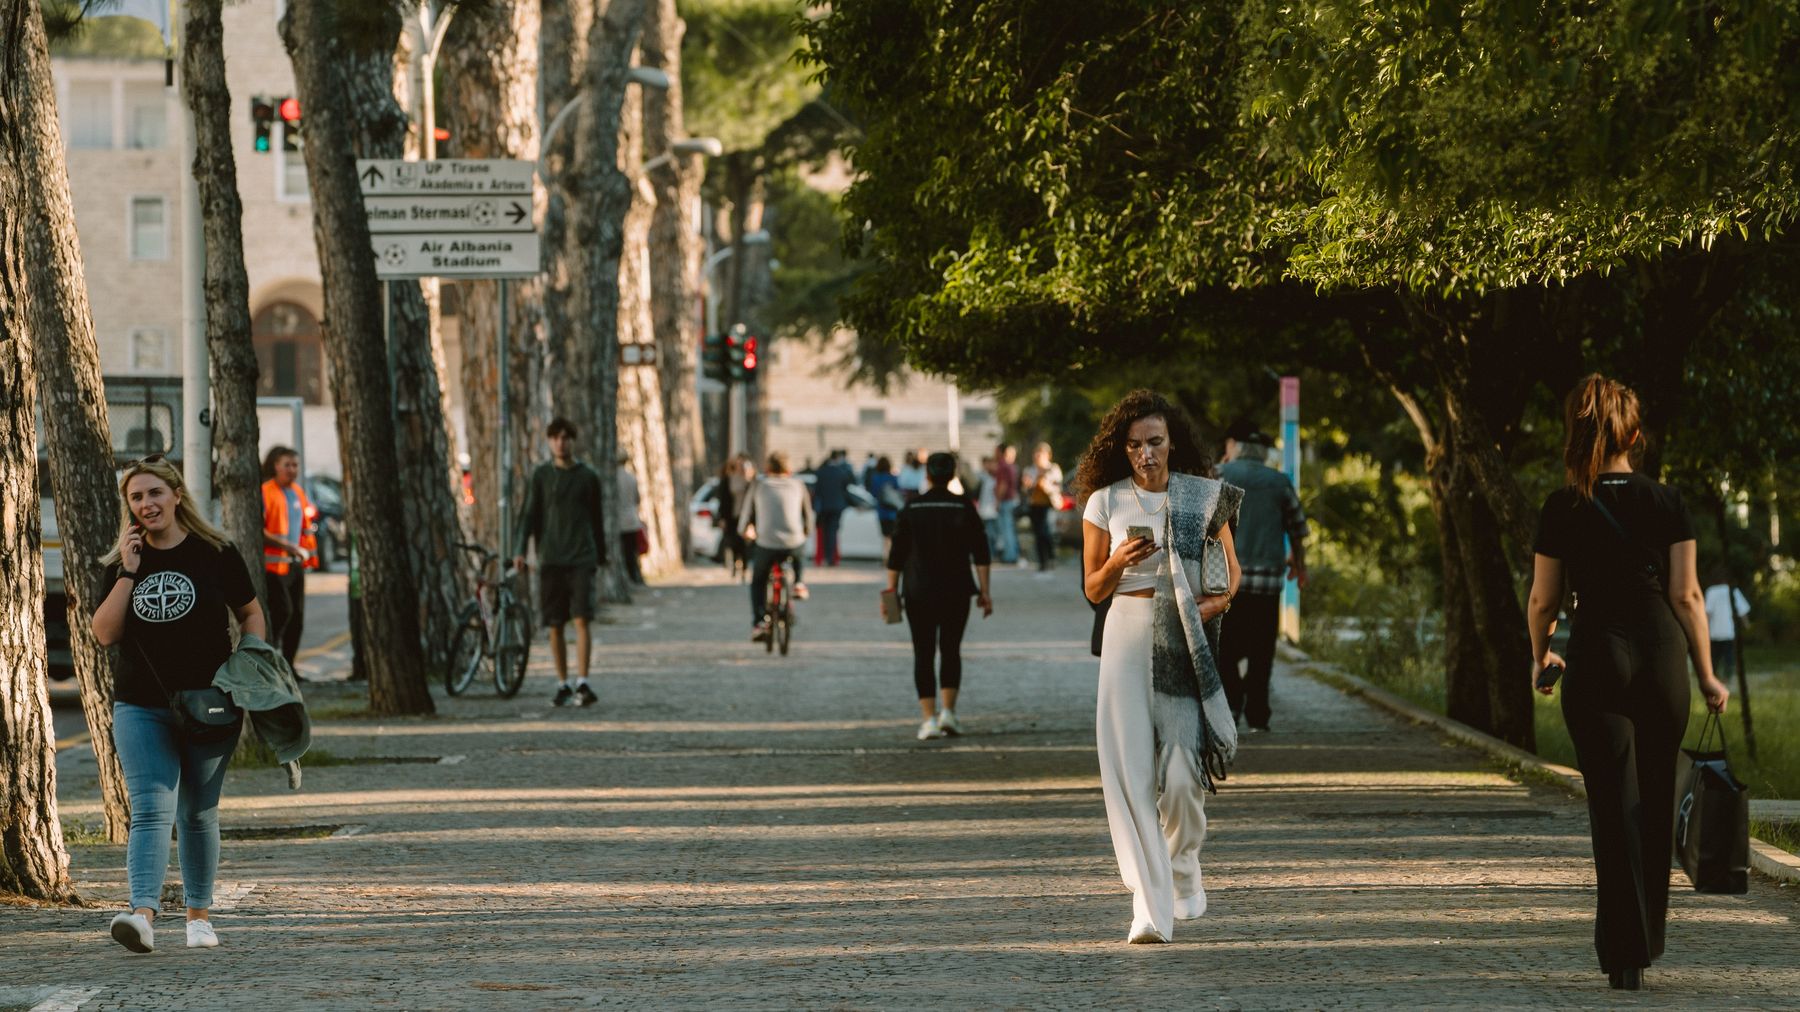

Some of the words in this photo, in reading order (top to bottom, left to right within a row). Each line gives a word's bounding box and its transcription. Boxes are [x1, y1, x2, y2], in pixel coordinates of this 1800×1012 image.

[425, 163, 443, 174] UP
[420, 179, 473, 190] Akademia
[477, 181, 484, 190] e
[367, 206, 406, 219] elman
[411, 204, 470, 220] Stermasi
[420, 240, 443, 252] Air
[449, 240, 513, 252] Albania
[433, 256, 500, 266] Stadium
[136, 576, 159, 594] STONE
[165, 574, 189, 592] ISLAND
[136, 596, 159, 619] ISLAND
[166, 594, 191, 618] STONE
